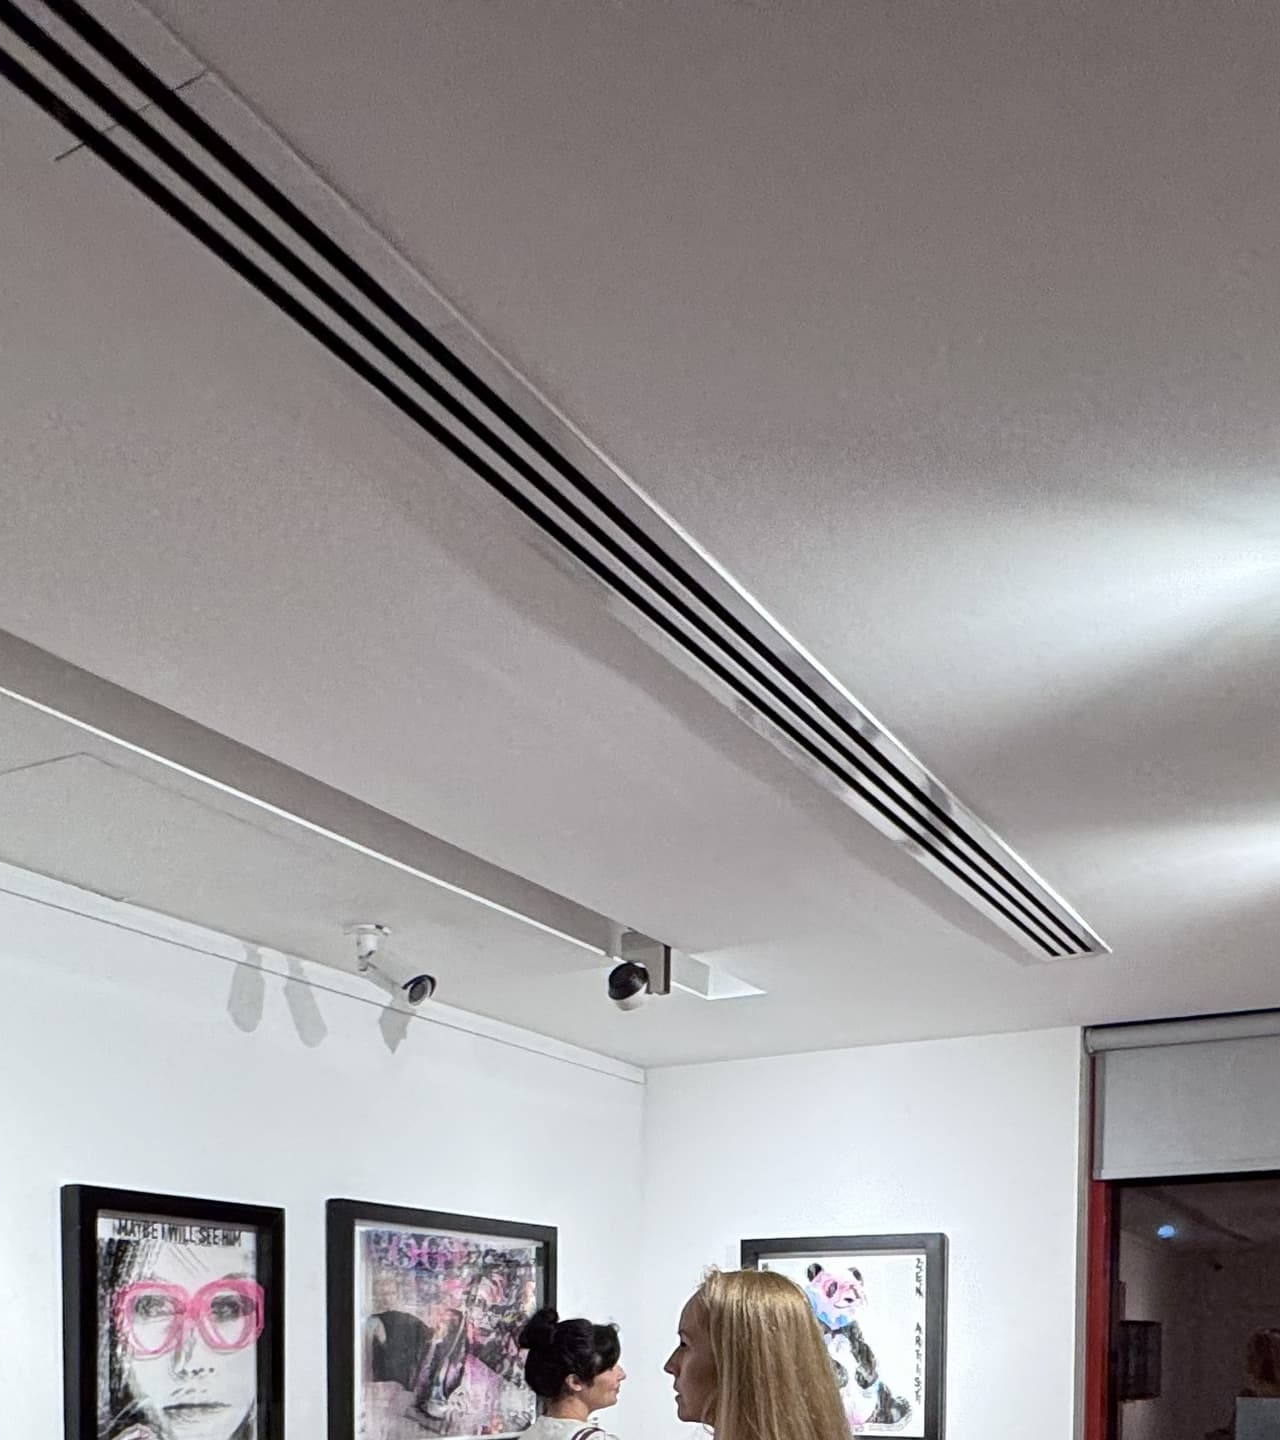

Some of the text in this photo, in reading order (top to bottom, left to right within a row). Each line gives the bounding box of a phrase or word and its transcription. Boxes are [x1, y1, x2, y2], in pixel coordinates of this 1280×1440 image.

[117, 1219, 159, 1240] MAYBE
[167, 1224, 198, 1243] WILL
[199, 1226, 221, 1245] SEE
[914, 1257, 924, 1404] ZEN ARTIST
